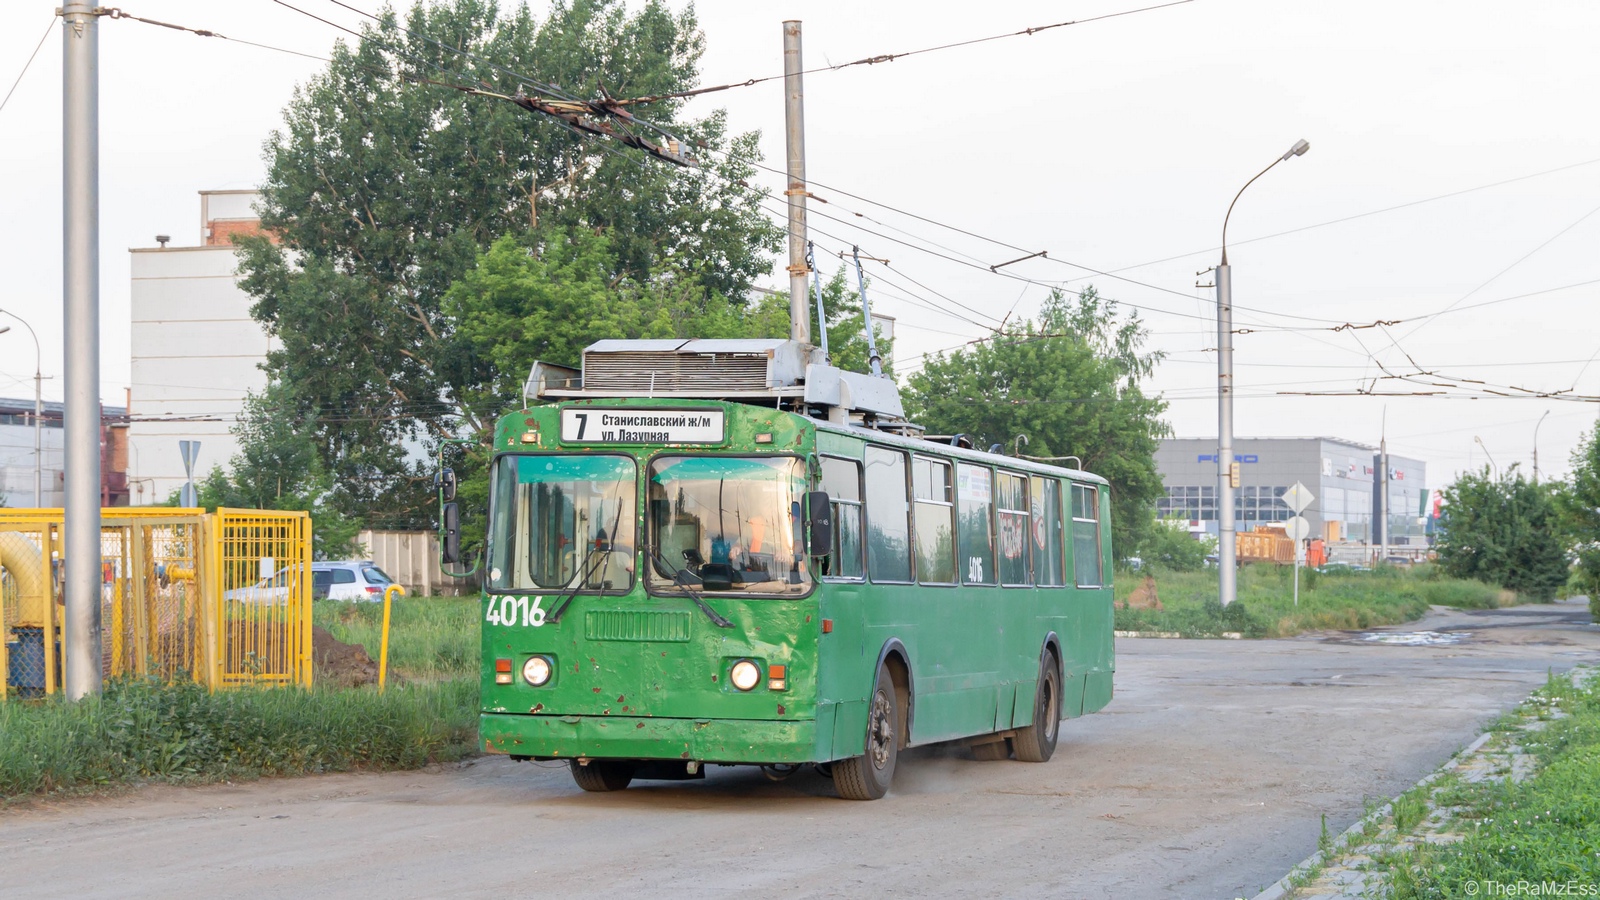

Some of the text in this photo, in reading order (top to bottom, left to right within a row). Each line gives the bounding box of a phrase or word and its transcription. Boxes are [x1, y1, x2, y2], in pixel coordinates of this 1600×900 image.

[575, 413, 711, 440] 7 Станиславский ж/м
[968, 556, 983, 583] 4016
[486, 595, 546, 627] 4016
